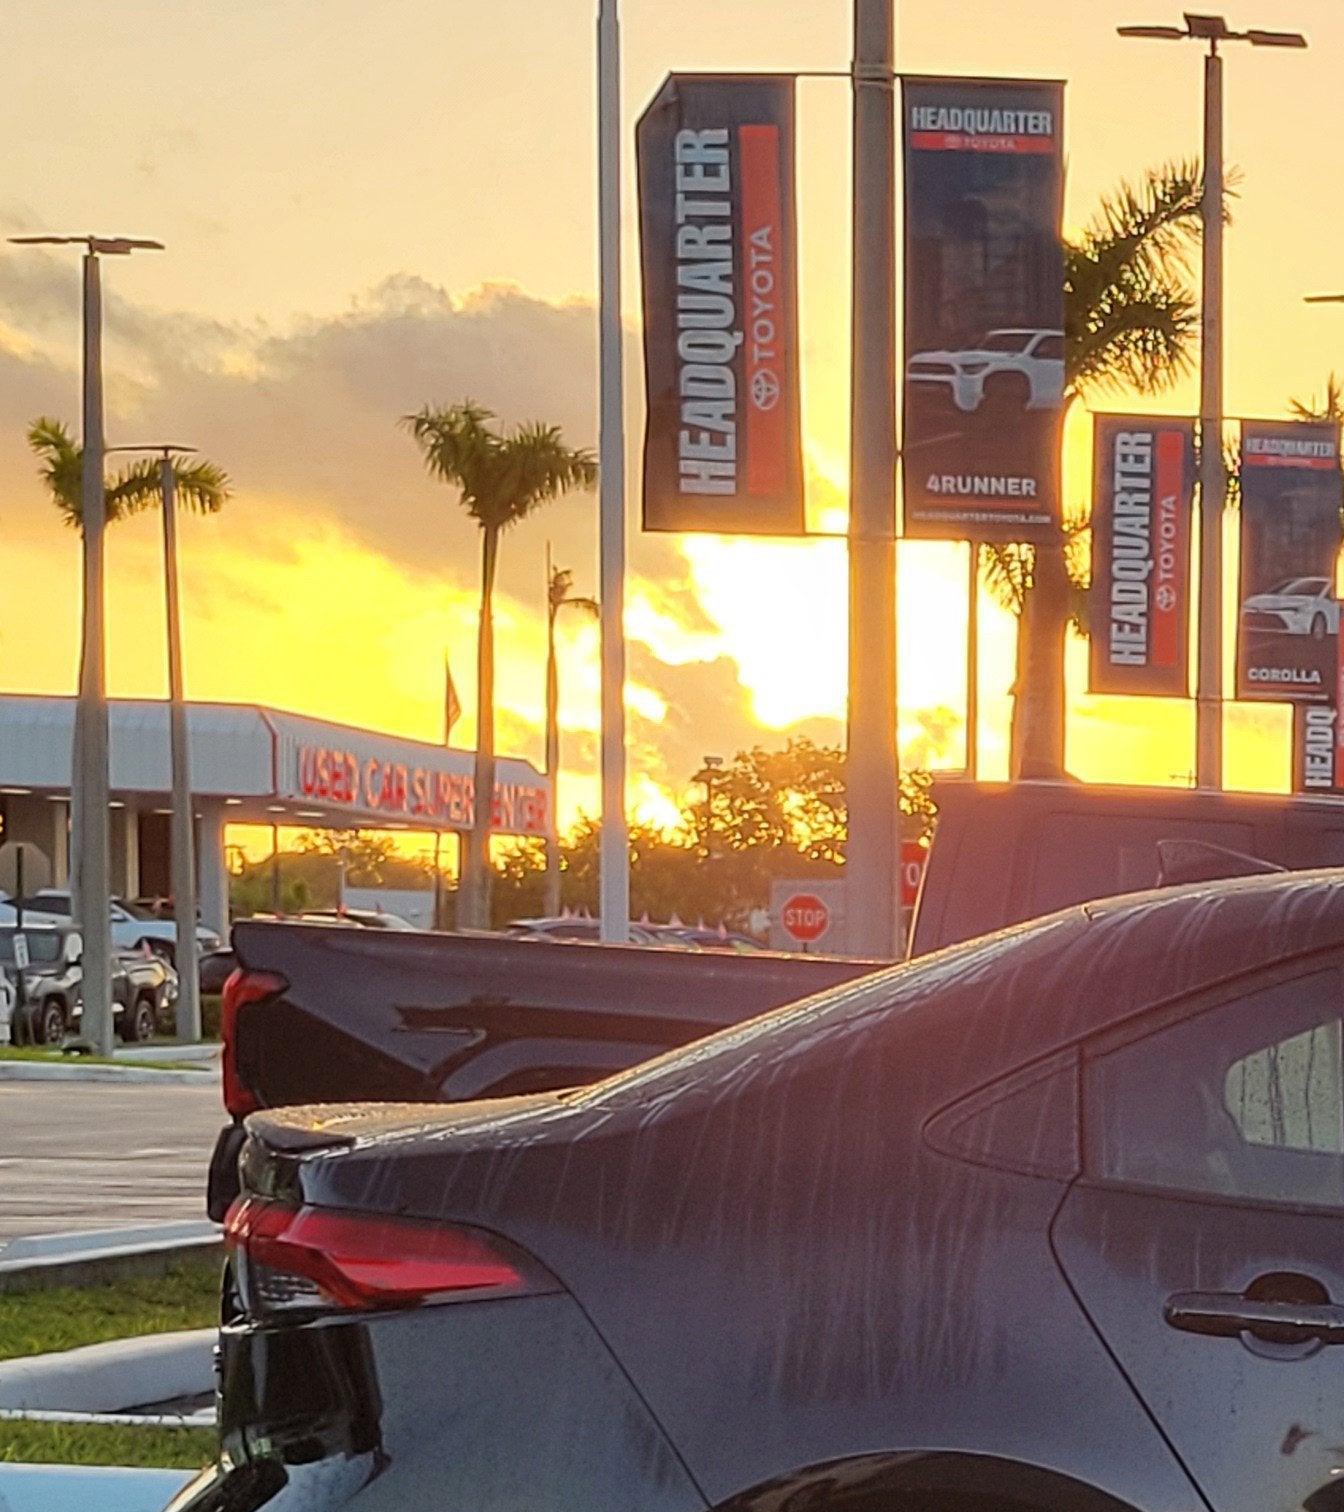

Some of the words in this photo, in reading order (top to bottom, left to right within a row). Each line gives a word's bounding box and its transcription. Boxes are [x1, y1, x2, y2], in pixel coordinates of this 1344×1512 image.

[912, 107, 1052, 134] HEADQUARTER
[676, 128, 744, 496] HEADQUARTER
[750, 226, 775, 363] TOYOTA
[926, 474, 1037, 496] 4RUNNER
[1110, 432, 1154, 665] HEADQUARTER
[1159, 495, 1177, 580] TOYOTA
[1247, 667, 1322, 683] COROLLA
[299, 745, 359, 803] USED
[365, 758, 407, 812] CAR
[1305, 705, 1338, 787] HEADQ
[786, 908, 826, 927] STOP
